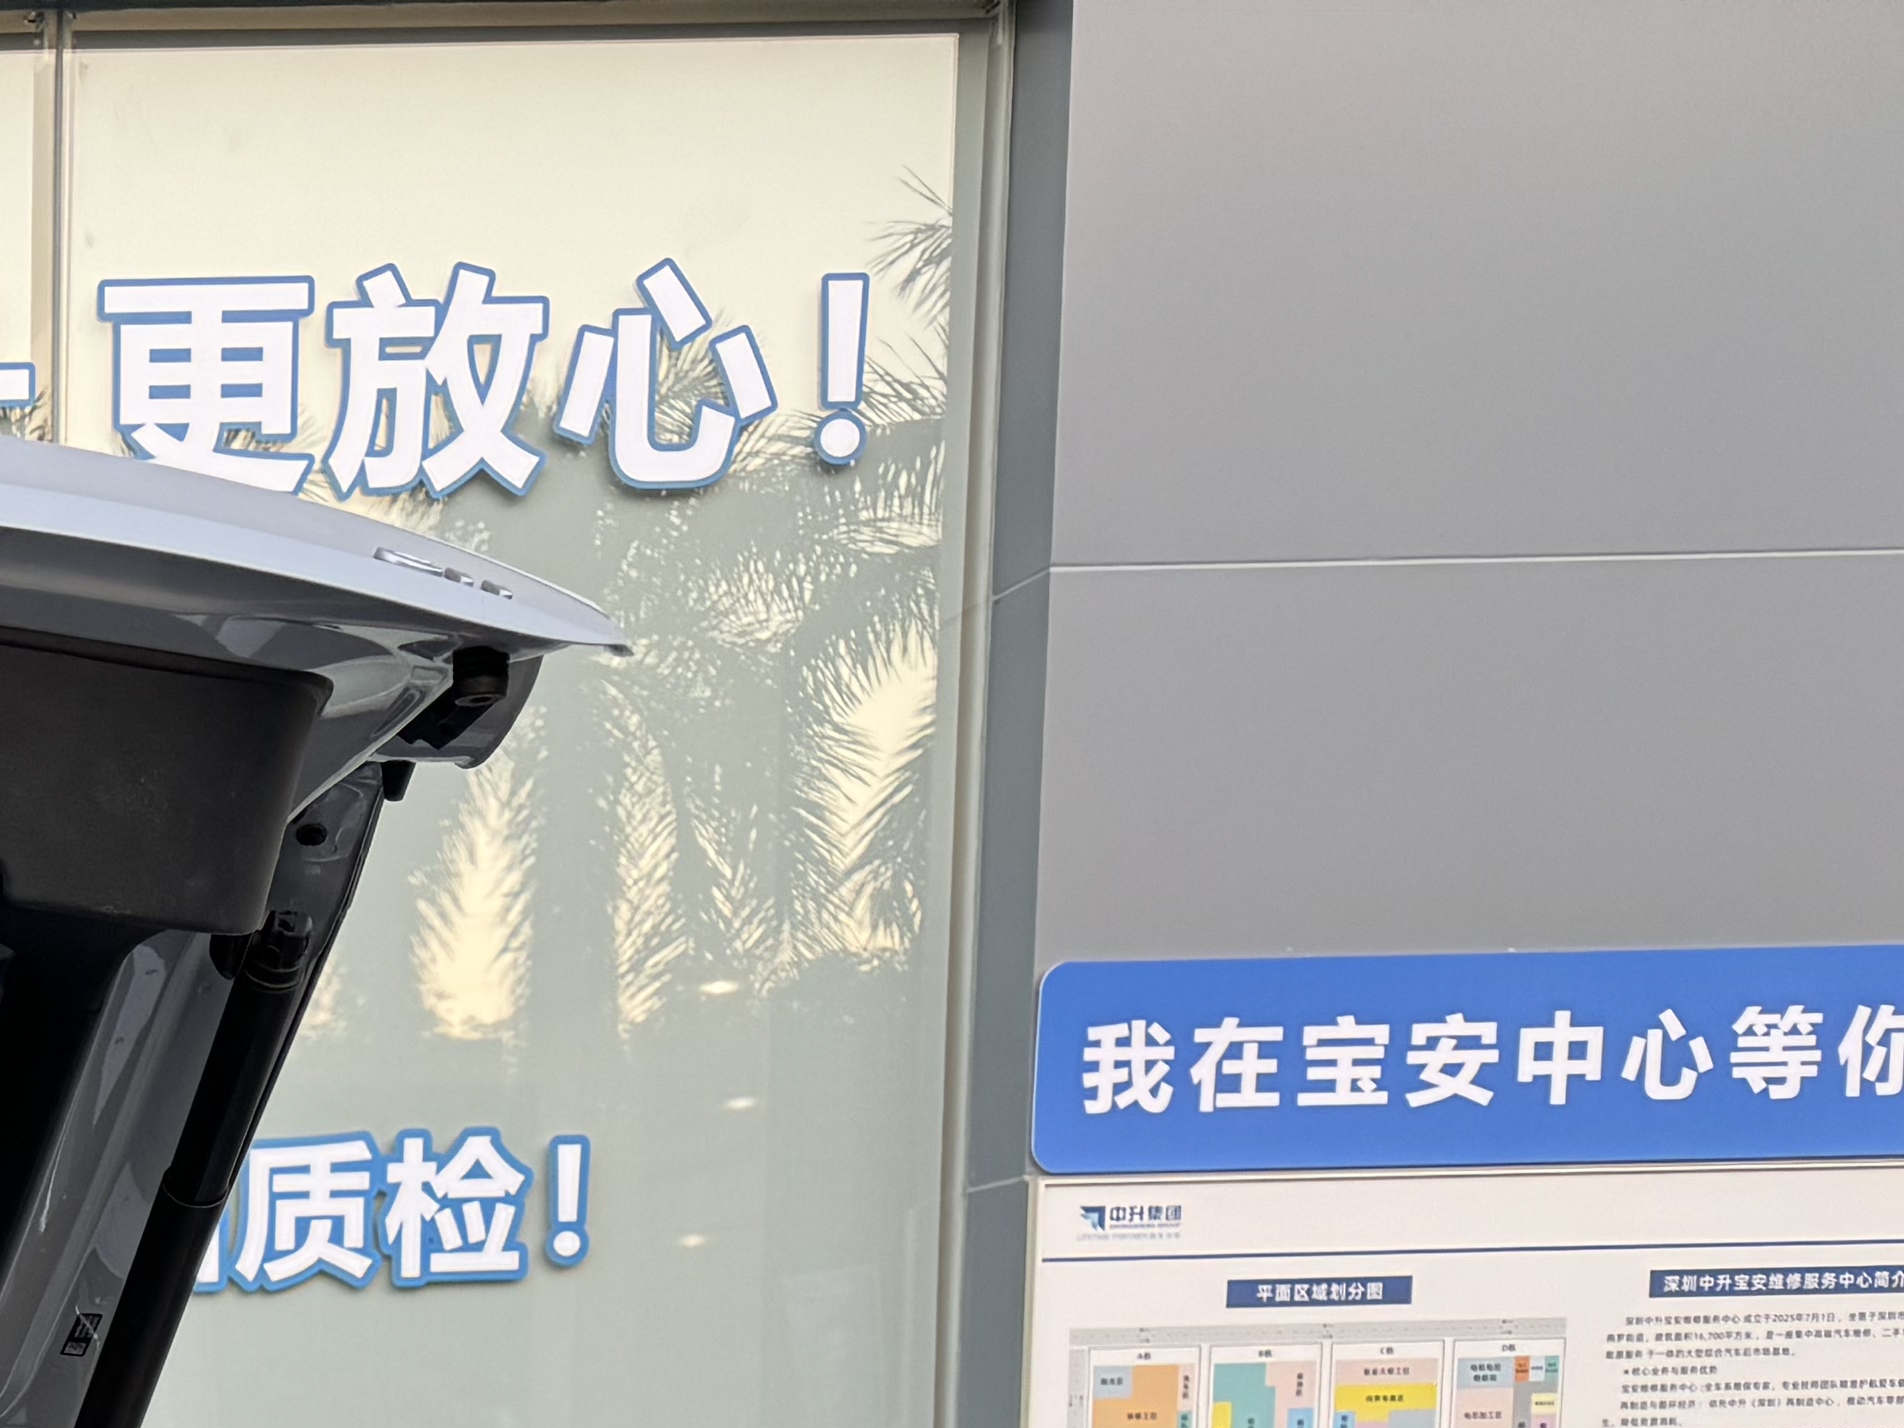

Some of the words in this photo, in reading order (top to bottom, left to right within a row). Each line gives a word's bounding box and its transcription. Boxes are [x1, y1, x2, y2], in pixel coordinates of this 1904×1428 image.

[1082, 1005, 1904, 1114] 我在宝安中心等你
[193, 1127, 590, 1293] 质检！
[1109, 1205, 1181, 1222] 中升集团
[1256, 1282, 1383, 1302] 平面区域划分图
[1664, 1271, 1904, 1292] 深圳中升宝安维修服务中心简介
